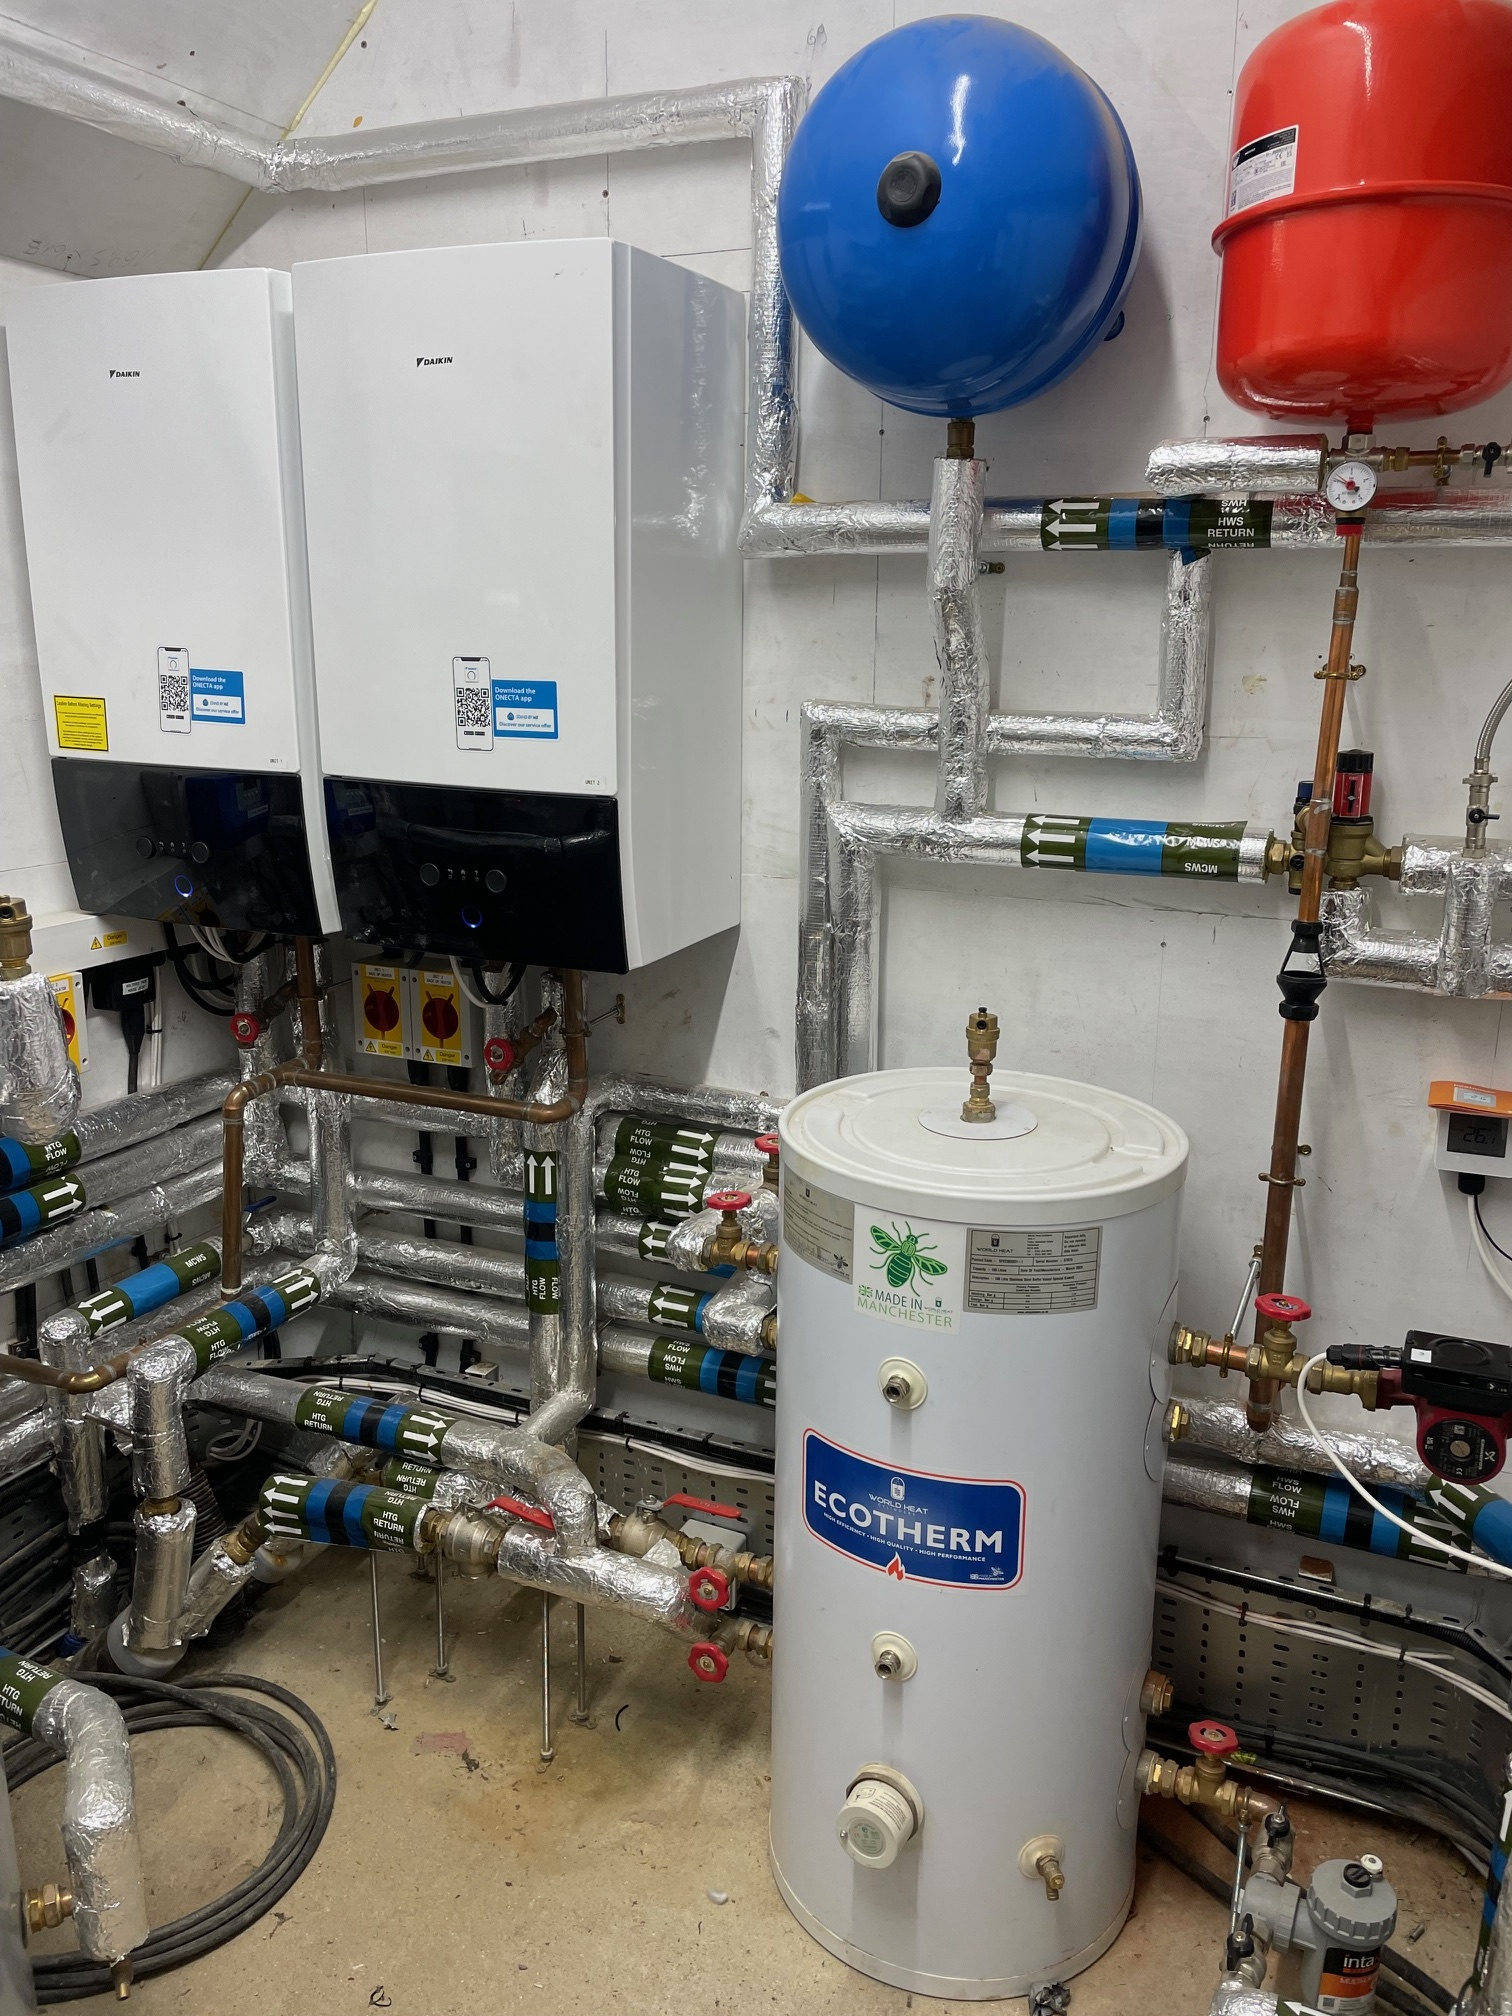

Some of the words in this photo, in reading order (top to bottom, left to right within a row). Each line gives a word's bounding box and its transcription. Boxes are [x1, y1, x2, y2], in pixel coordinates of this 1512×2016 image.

[423, 356, 454, 366] DAIKIN
[1218, 517, 1244, 526] HWS
[1208, 528, 1254, 537] RETURN
[1185, 862, 1218, 873] MCWS
[45, 1141, 62, 1152] HTG
[630, 1136, 652, 1146] FLOW
[45, 1148, 67, 1161] FLOW
[630, 1148, 651, 1158] FLOW
[631, 1157, 646, 1166] HTG
[624, 1168, 640, 1176] HTG
[618, 1175, 640, 1186] FLOW
[618, 1188, 638, 1198] FLOW
[184, 1254, 207, 1268] MCWS
[191, 1271, 211, 1286] MCWS
[875, 1290, 907, 1307] MADE
[911, 1298, 922, 1310] IN
[857, 1297, 952, 1327] MANCHESTER
[196, 1321, 218, 1332] FLOW
[204, 1326, 220, 1337] HTG
[211, 1340, 226, 1351] HTG
[667, 1344, 690, 1353] FLOW
[663, 1354, 686, 1365] FLOW
[665, 1363, 682, 1373] HWS
[313, 1390, 344, 1402] RETURN
[316, 1398, 332, 1408] HTG
[312, 1412, 326, 1422] HTG
[304, 1420, 333, 1432] RETURN
[402, 1462, 432, 1474] RETURN
[396, 1474, 426, 1486] RETURN
[1276, 1476, 1300, 1485] HWS
[403, 1484, 417, 1493] HTG
[1272, 1481, 1302, 1494] FLOW
[387, 1497, 404, 1506] HTG
[868, 1493, 902, 1508] WORLD
[904, 1505, 928, 1515] HEAT
[1270, 1494, 1300, 1509] FLOW
[382, 1510, 398, 1521] HTG
[1272, 1505, 1295, 1517] HWS
[814, 1480, 1003, 1554] ECOTHERM
[373, 1518, 404, 1533] RETURN
[1270, 1520, 1292, 1530] HWS
[374, 1530, 404, 1545] RETURN
[824, 1512, 836, 1523] HIGH
[837, 1520, 866, 1537] EFFICIENCY
[870, 1535, 885, 1544] HIGH
[886, 1541, 914, 1551] QUALITY
[938, 1552, 986, 1562] PERFORMANCE
[16, 1668, 36, 1682] HTG
[18, 1660, 53, 1679] RETURN
[2, 1684, 20, 1700] HTG
[0, 1694, 23, 1716] TURN
[1343, 1954, 1374, 1968] inta
